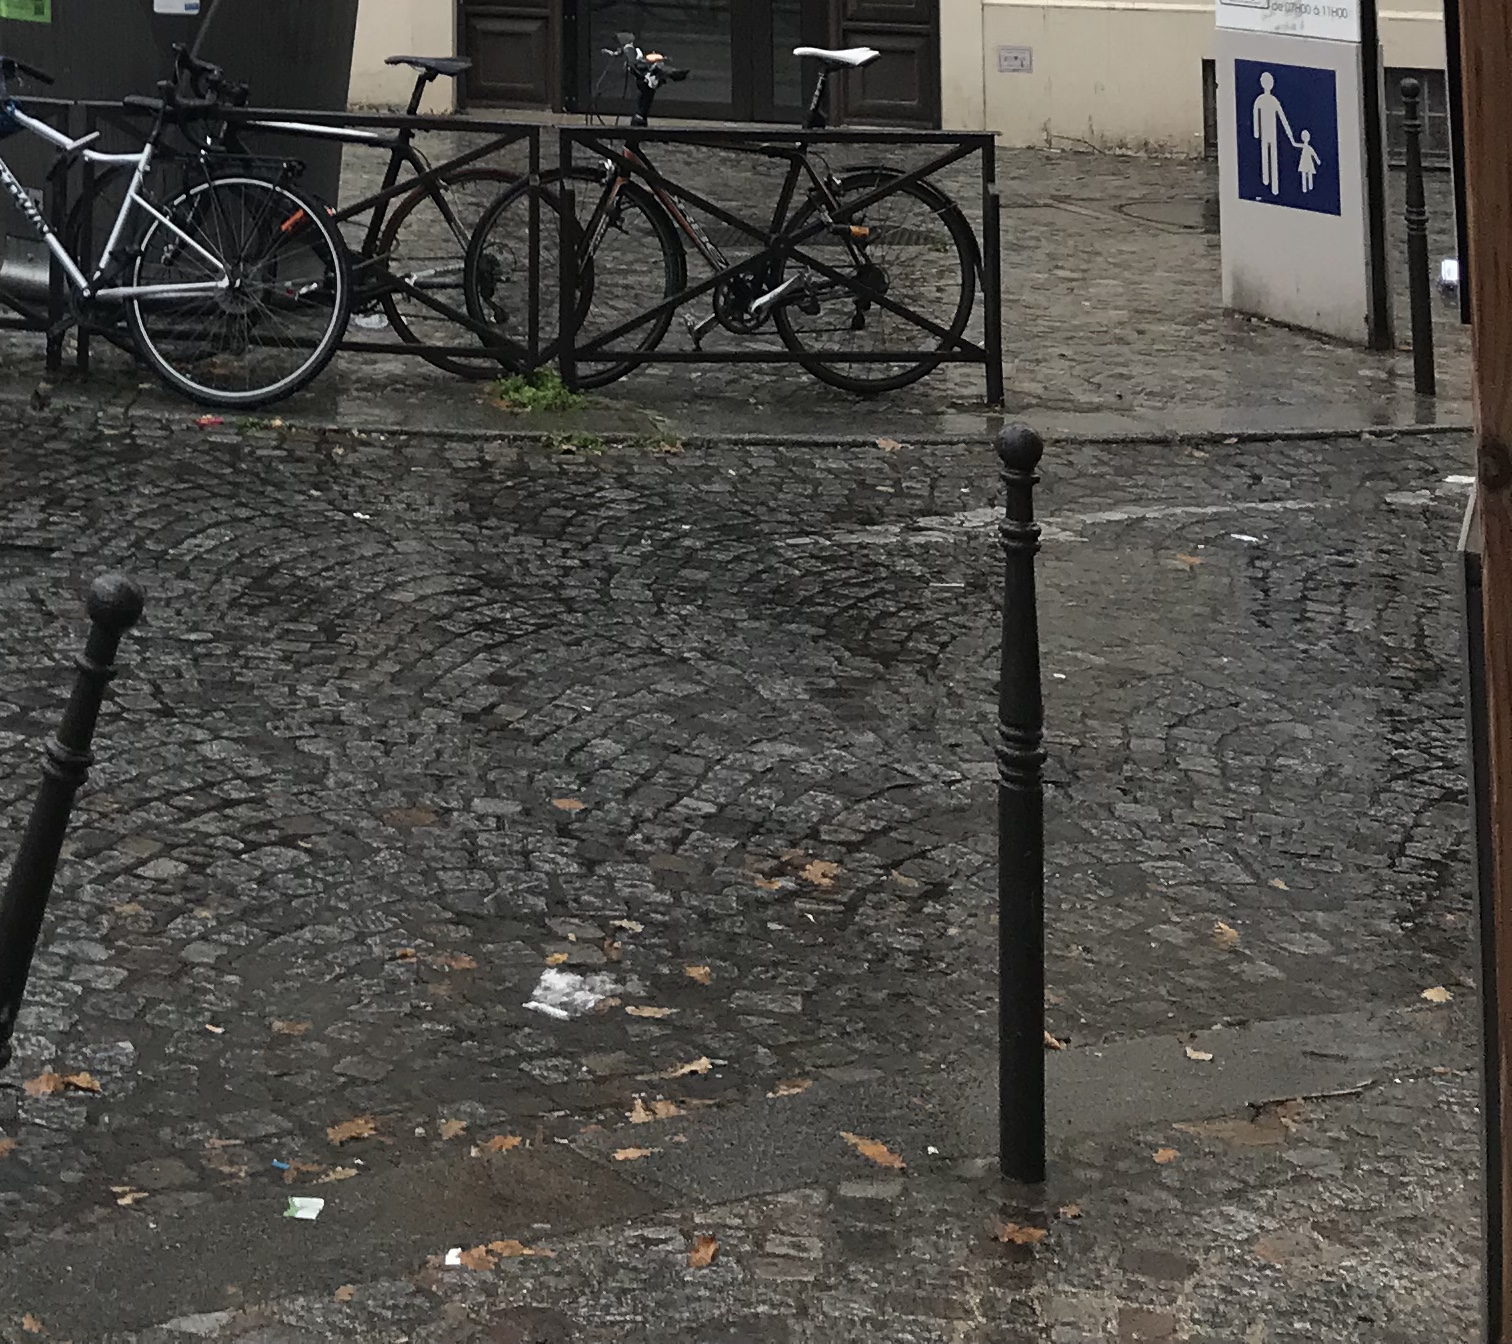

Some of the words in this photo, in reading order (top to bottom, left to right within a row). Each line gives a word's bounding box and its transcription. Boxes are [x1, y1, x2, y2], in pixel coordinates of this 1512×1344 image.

[1271, 2, 1284, 12] de
[1313, 5, 1320, 15] à
[1322, 7, 1348, 18] 11H00
